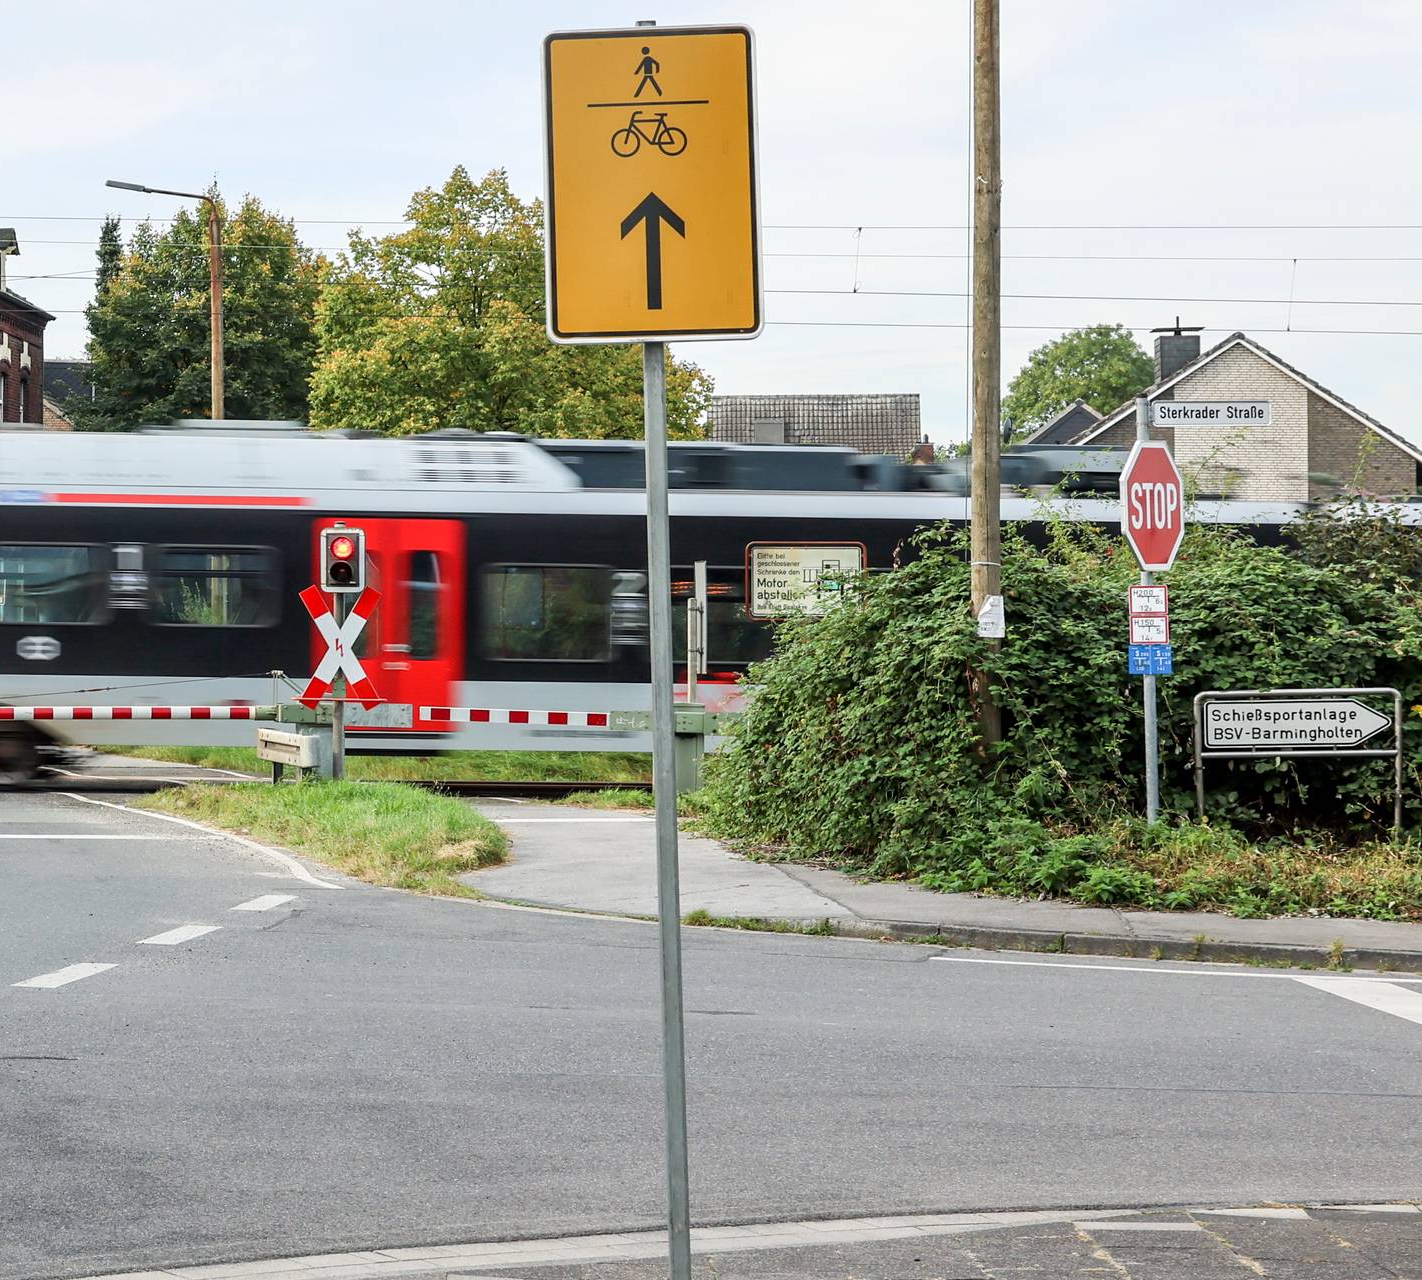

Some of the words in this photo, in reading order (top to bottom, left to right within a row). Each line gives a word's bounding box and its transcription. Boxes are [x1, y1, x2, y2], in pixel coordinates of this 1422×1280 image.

[1159, 405, 1220, 419] Sterkrader
[1226, 405, 1265, 419] Straße
[1131, 482, 1178, 530] STOP
[757, 578, 787, 587] Motor
[1211, 708, 1358, 724] Schießsportanlage
[1213, 726, 1363, 742] BSV-Barmingholten
